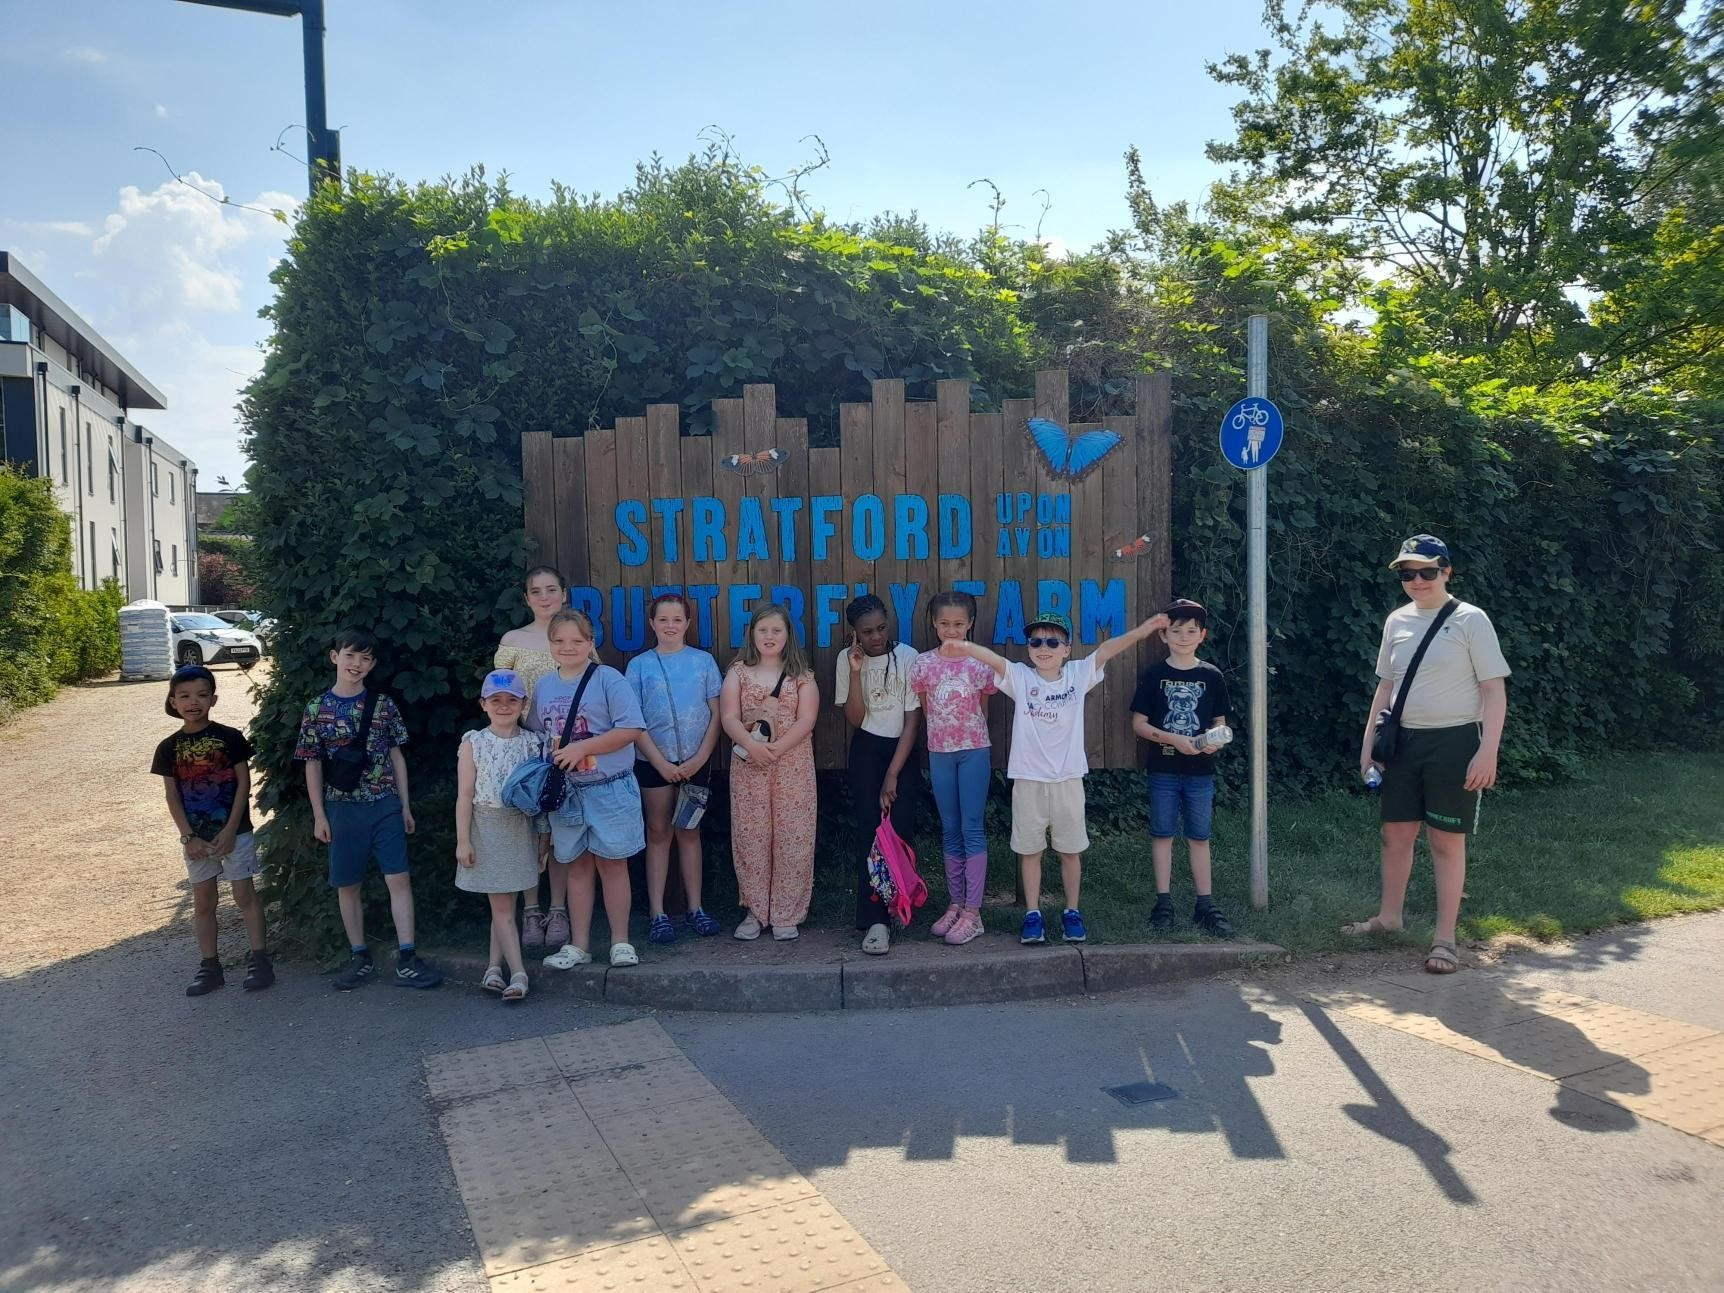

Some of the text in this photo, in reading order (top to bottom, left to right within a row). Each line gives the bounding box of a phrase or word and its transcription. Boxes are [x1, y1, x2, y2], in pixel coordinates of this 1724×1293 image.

[615, 493, 973, 567] STRATFORD
[996, 491, 1072, 526] UPON
[996, 526, 1071, 560] AVON
[570, 583, 921, 652] BUTERFY
